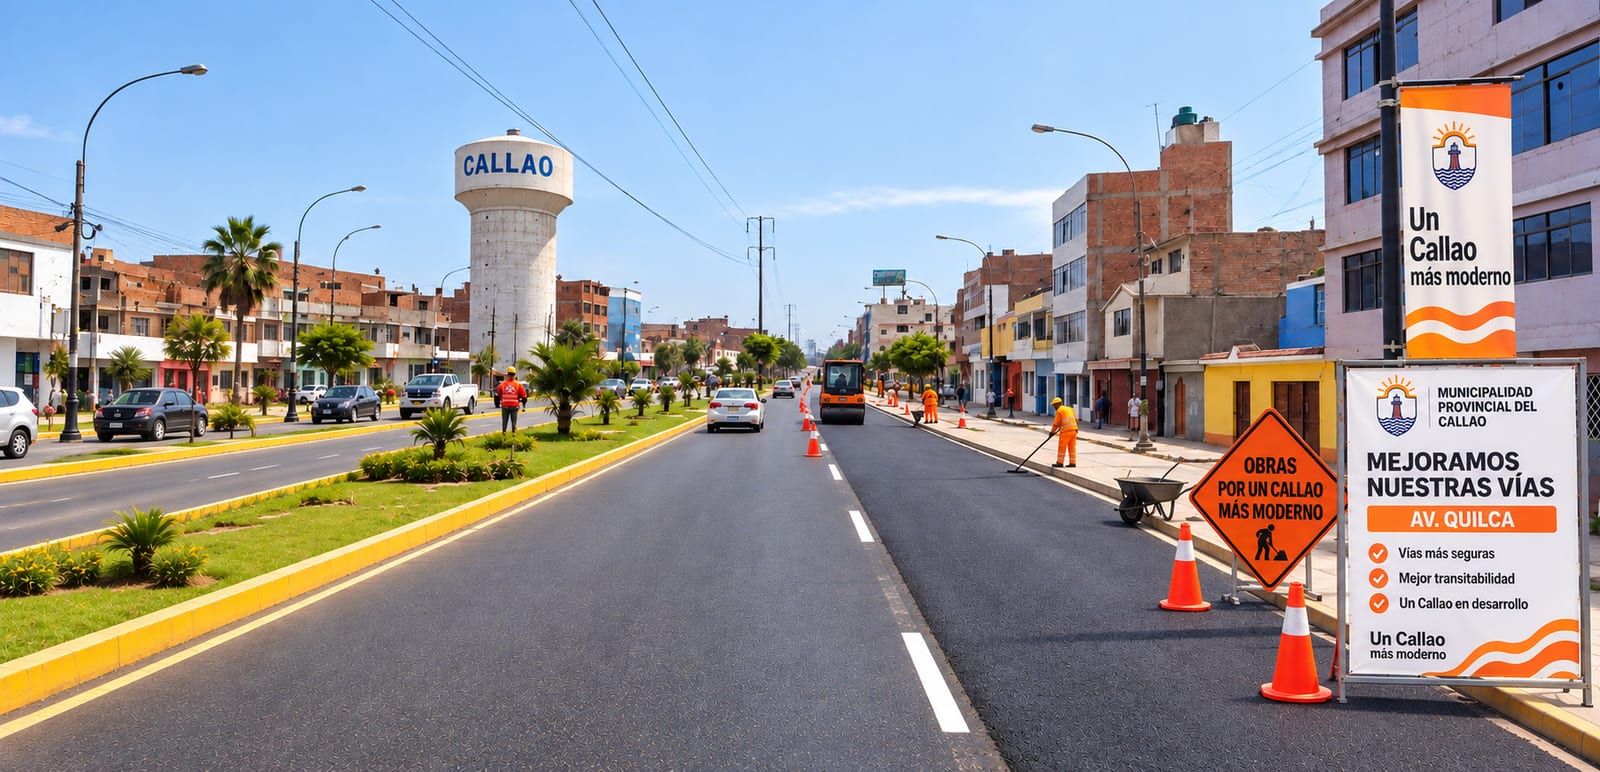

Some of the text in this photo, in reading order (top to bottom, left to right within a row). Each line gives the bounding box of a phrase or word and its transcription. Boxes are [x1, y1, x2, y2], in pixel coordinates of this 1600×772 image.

[464, 152, 553, 177] CALLAO
[1409, 207, 1439, 231] Un
[1410, 235, 1477, 262] Callao
[1411, 266, 1511, 286] más moderno
[1438, 386, 1533, 399] MUNICIPALIDAD
[1438, 401, 1537, 413] PROVINCIAL DEL
[1438, 416, 1487, 427] CALLAO
[1244, 457, 1297, 474] OBRAS
[1367, 451, 1520, 472] MEJORAMOS
[1218, 481, 1323, 498] POR UN CALLAO
[1367, 473, 1555, 497] NUESTRAS VÍAS
[1218, 500, 1323, 520] MÁS MODERNO
[1410, 511, 1515, 529] AV. QUILCA
[1425, 547, 1448, 559] más
[1452, 549, 1495, 562] seguras
[1399, 572, 1515, 586] Mejor transitabilidad
[1399, 598, 1529, 610] Un Callao en desarrollo
[1370, 631, 1445, 647] Un Callao
[1370, 648, 1446, 660] más moderno
